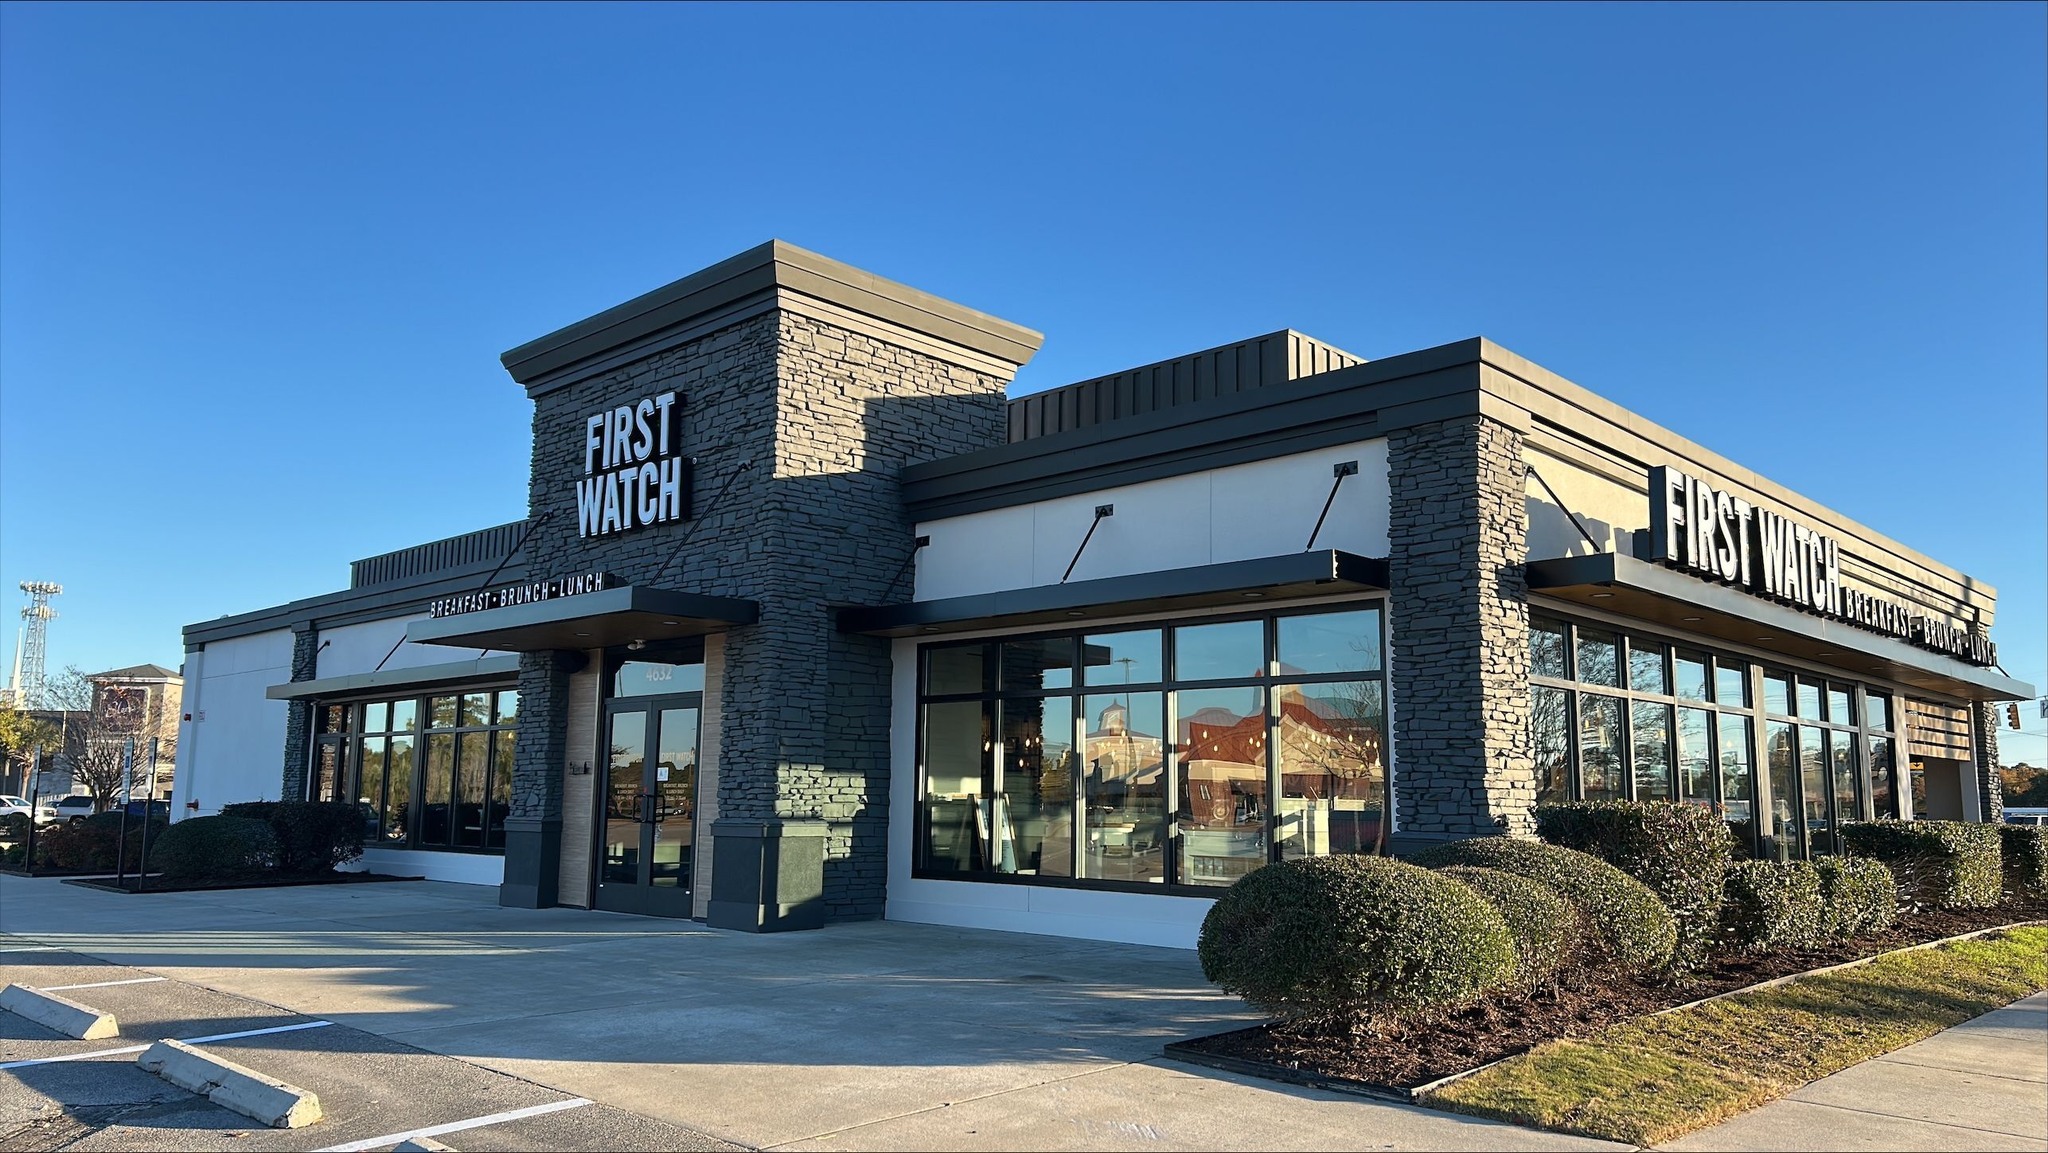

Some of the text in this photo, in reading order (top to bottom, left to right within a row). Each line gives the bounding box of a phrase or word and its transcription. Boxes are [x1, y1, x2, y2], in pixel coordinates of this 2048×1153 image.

[584, 391, 676, 475] FIRST
[576, 456, 682, 538] WATCH
[430, 572, 603, 618] BREAKFAST BRUNCH LUNCH
[1665, 465, 1752, 586] FIRST
[1758, 506, 1842, 616] WATCH
[1846, 587, 1912, 638] BREAKFAST
[1923, 615, 1963, 656] BRUNCH
[646, 666, 673, 681] 4632
